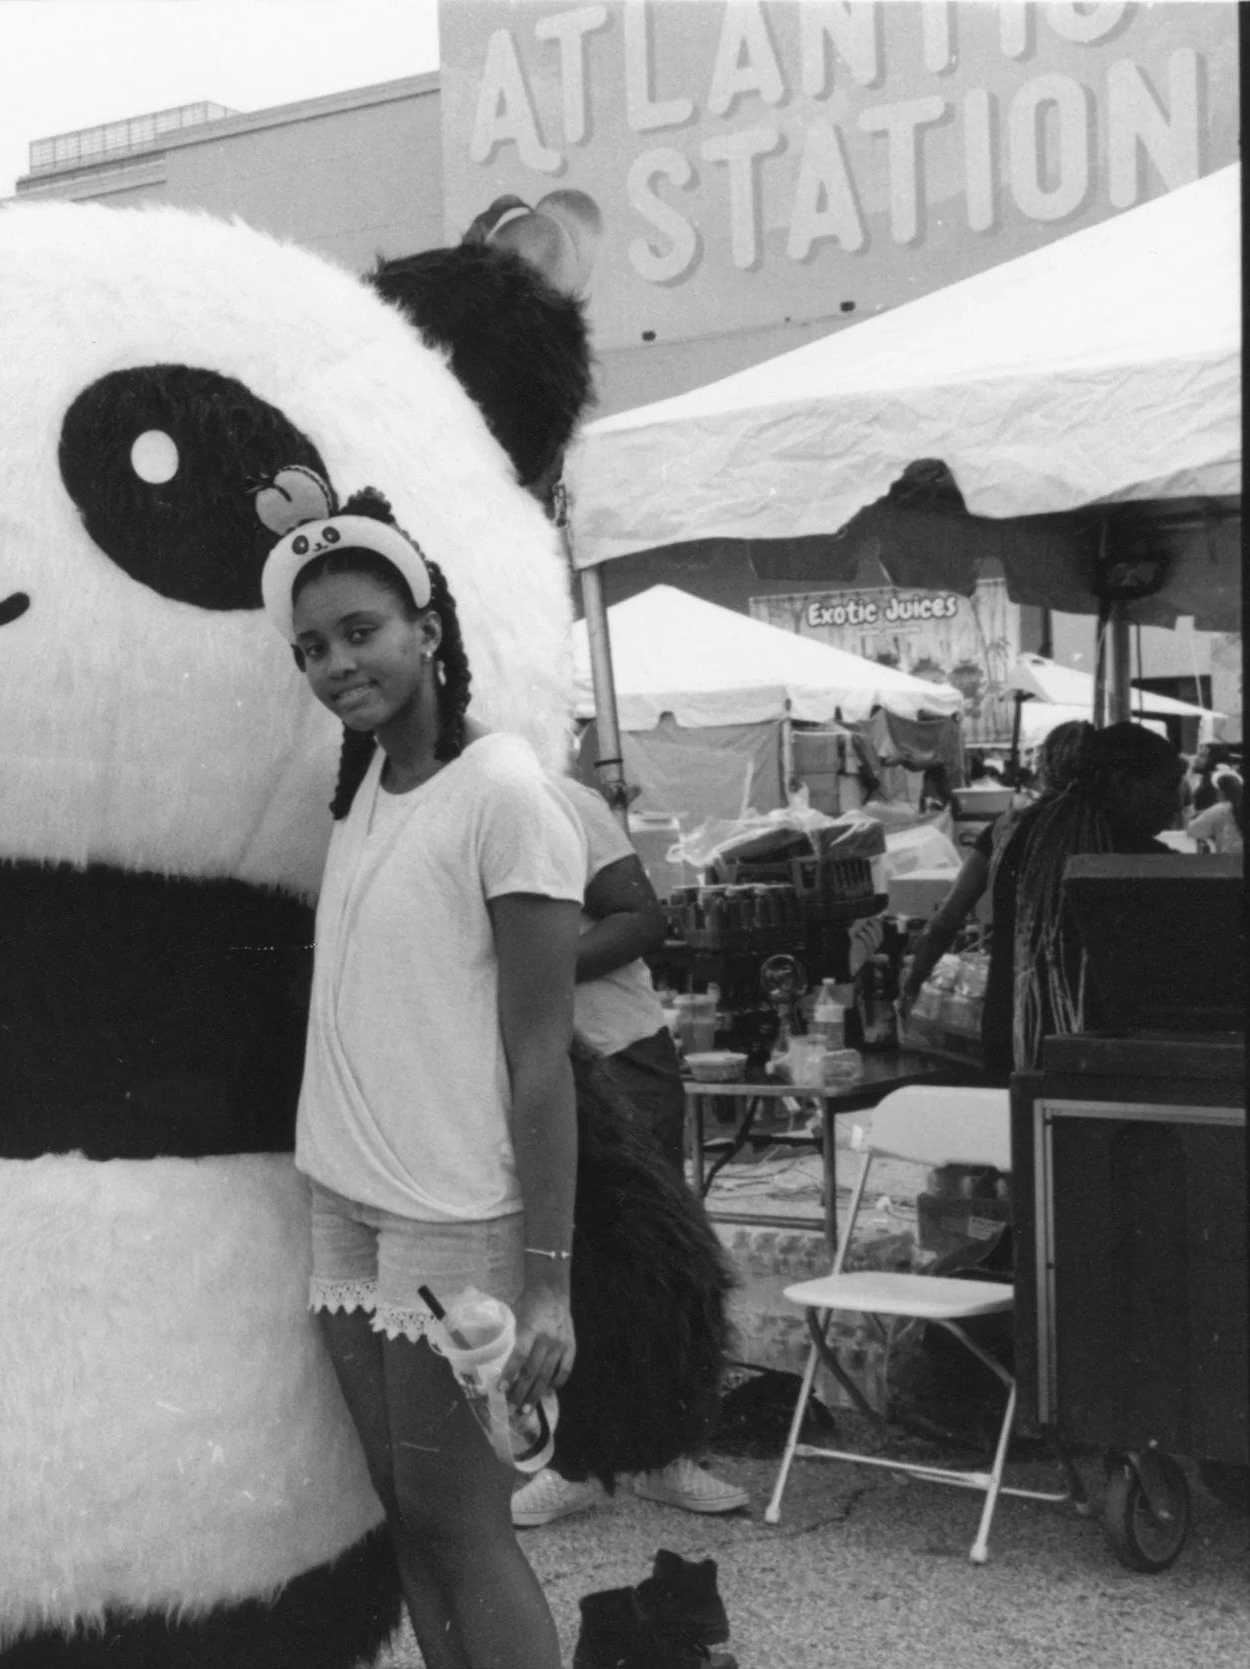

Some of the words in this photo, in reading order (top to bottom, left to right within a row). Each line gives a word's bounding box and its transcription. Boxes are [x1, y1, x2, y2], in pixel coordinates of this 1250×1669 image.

[470, 0, 1138, 178] ATLAN
[627, 47, 1206, 284] STATION
[808, 600, 878, 627] Exotic
[885, 595, 958, 622] Juices
